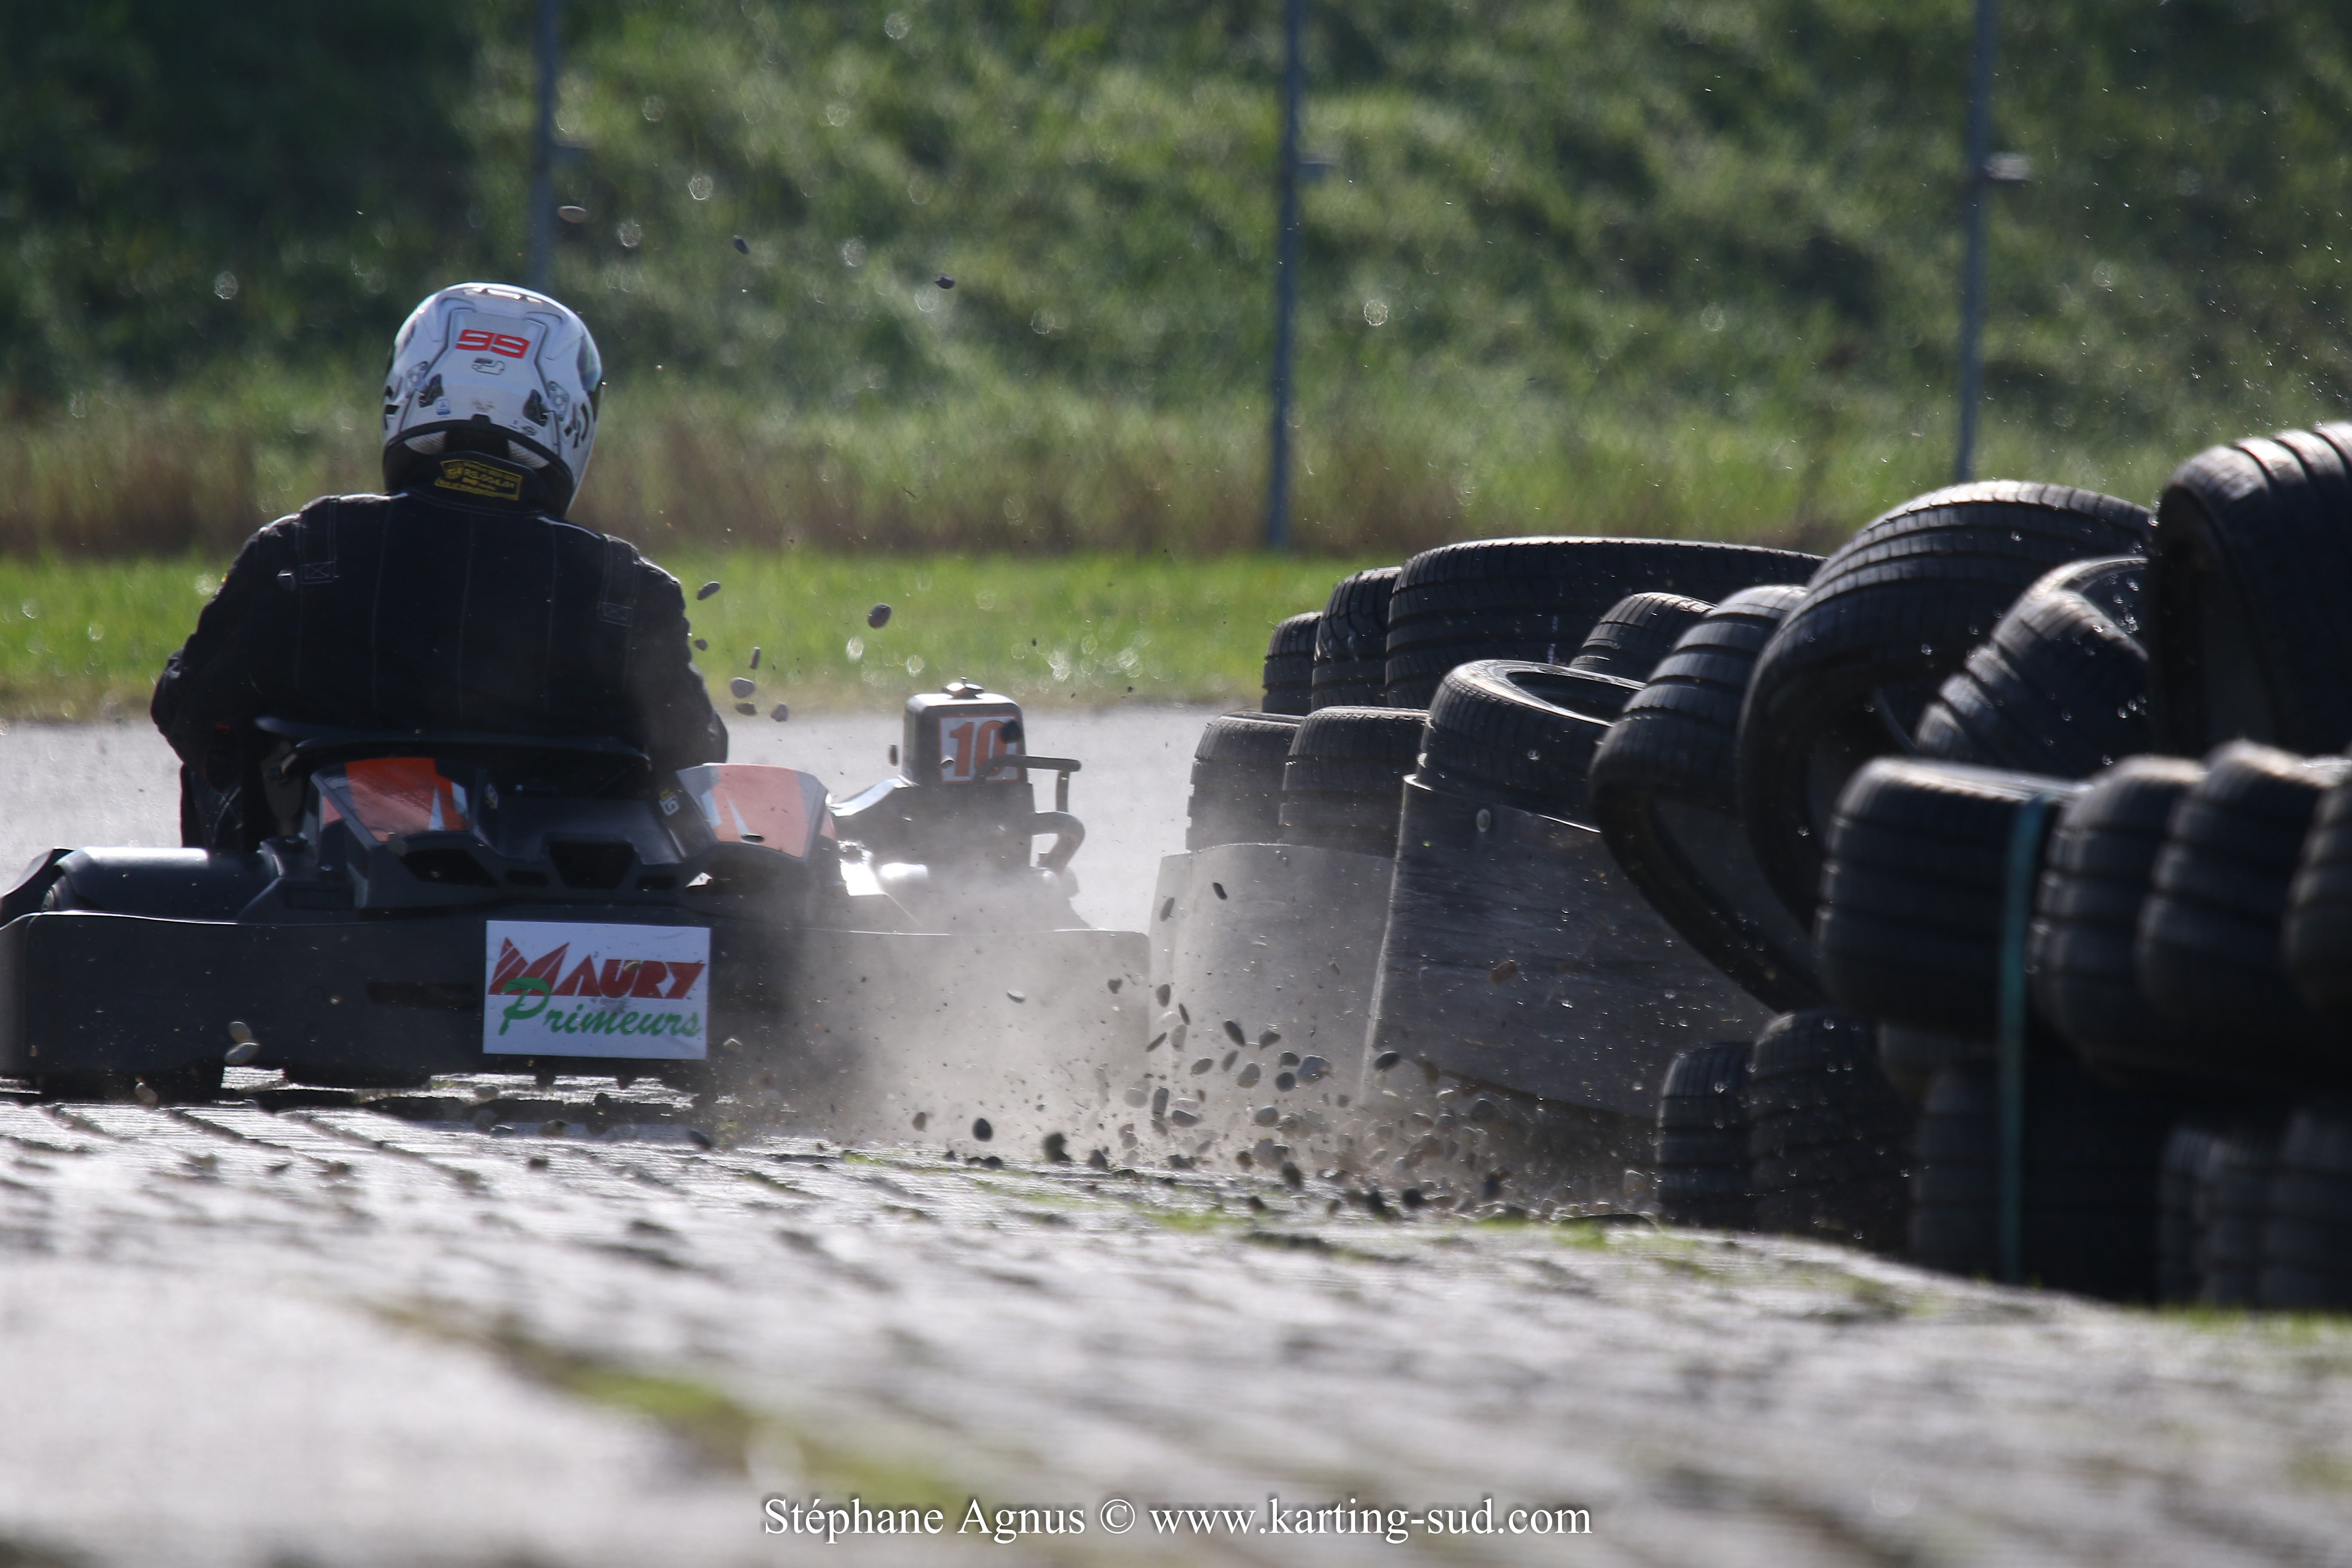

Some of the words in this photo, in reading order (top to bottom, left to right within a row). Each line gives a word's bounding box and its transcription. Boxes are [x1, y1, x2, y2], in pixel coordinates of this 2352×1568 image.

[456, 329, 530, 358] 99
[949, 720, 1008, 776] 10
[488, 936, 706, 999] MAURY
[499, 977, 701, 1037] Primeurs
